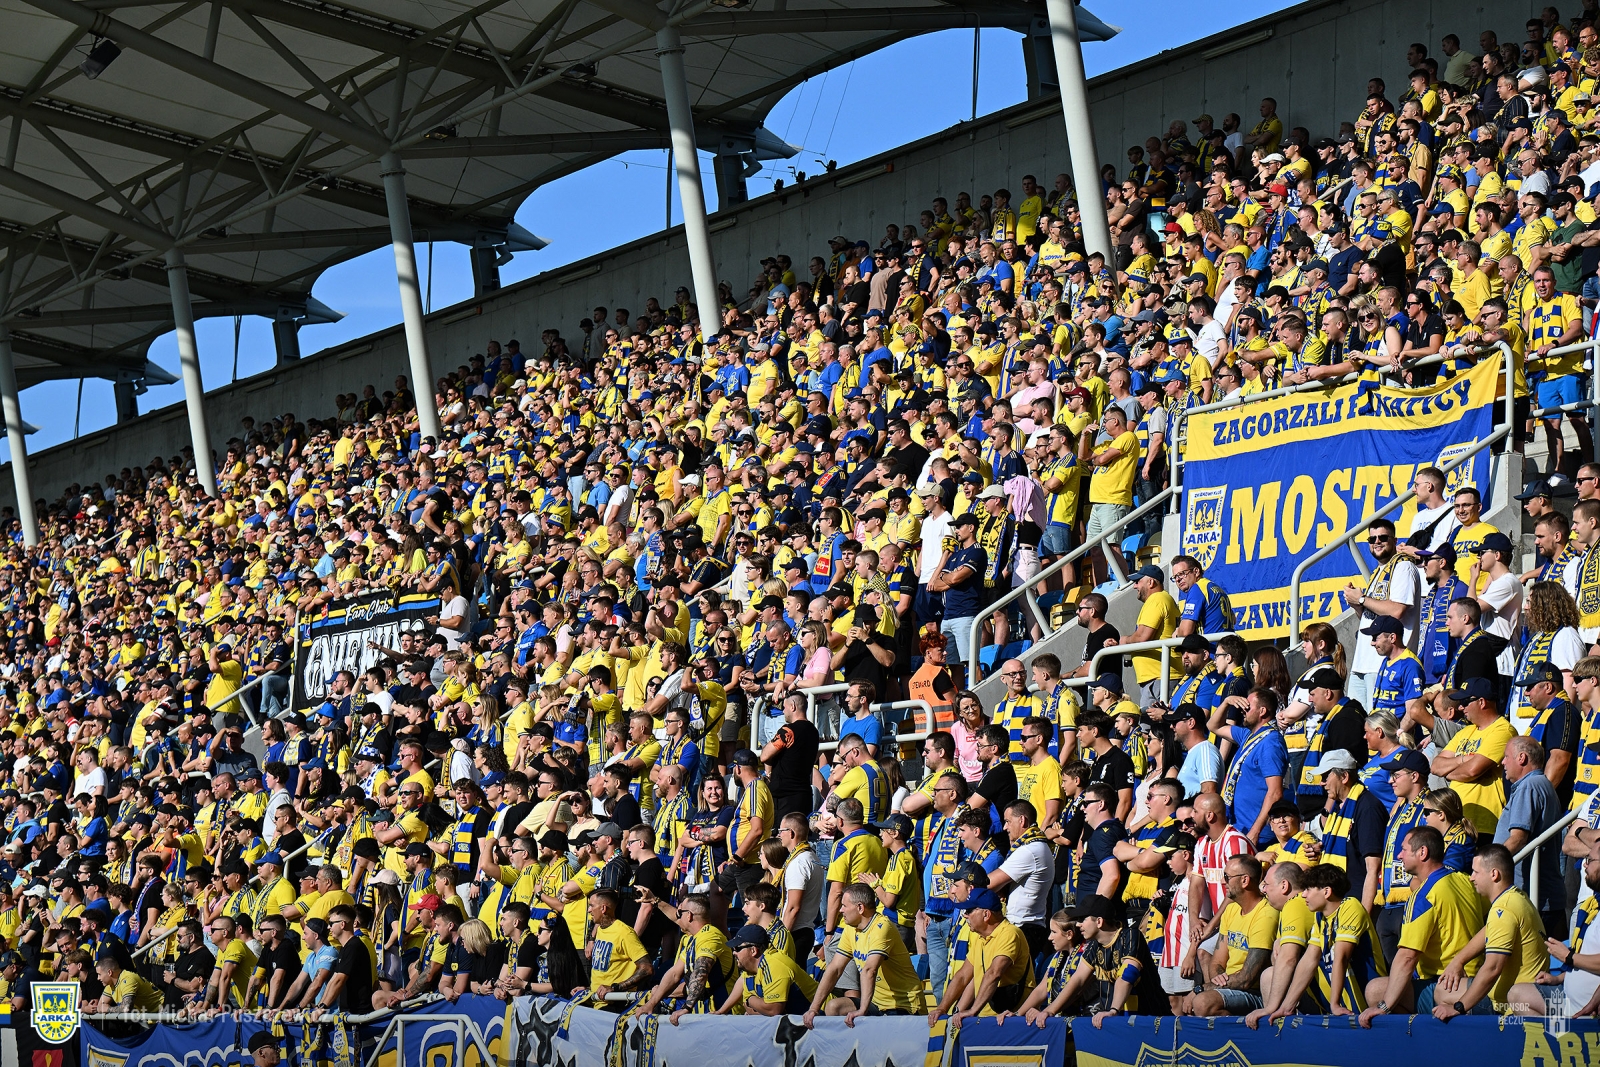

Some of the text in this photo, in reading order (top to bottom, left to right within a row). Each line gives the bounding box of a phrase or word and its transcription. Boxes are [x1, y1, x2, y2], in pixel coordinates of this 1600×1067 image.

[1213, 379, 1472, 446] ZAGORZALI FNATYCY
[1225, 461, 1434, 564] MOSTY
[1187, 531, 1217, 545] ARKA
[345, 598, 391, 626] Fan Club
[1231, 594, 1316, 632] ZAWE
[1318, 592, 1335, 618] Z
